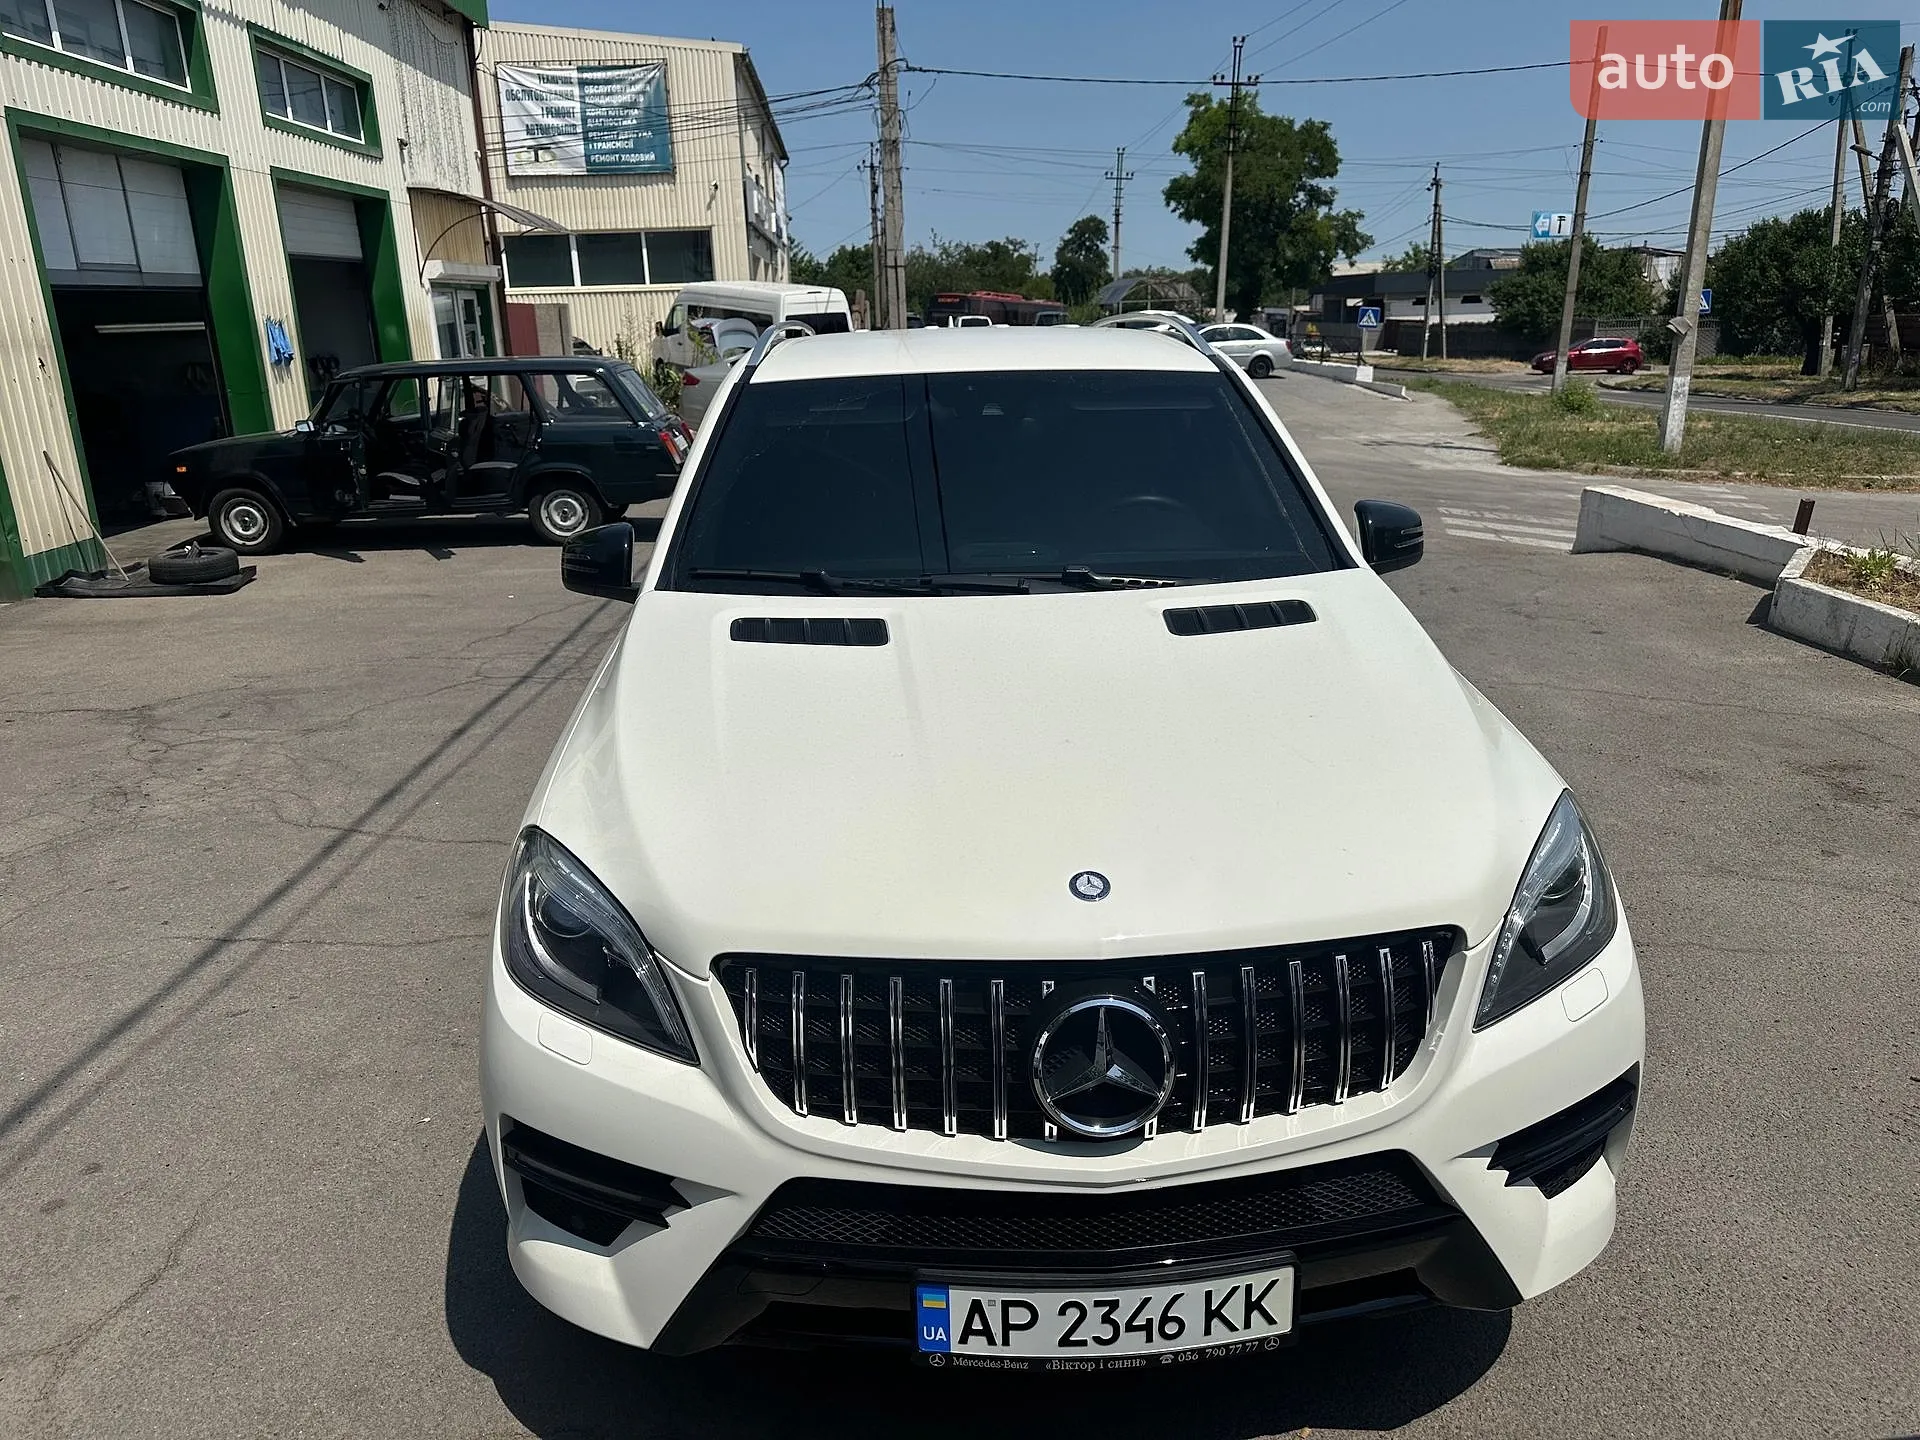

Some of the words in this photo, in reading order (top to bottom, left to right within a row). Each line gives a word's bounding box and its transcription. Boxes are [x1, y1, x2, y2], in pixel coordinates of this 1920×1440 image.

[546, 106, 576, 118] РЕМОНТ
[526, 123, 578, 136] АВТОМОБІЛІВ
[590, 153, 620, 163] РЕМОНТ
[957, 1297, 1039, 1347] AP
[1057, 1292, 1186, 1348] 2346
[1203, 1278, 1281, 1337] KK
[923, 1326, 948, 1342] UA
[1177, 1352, 1199, 1362] 056
[1205, 1347, 1226, 1359] 790
[1229, 1344, 1243, 1355] 77
[1245, 1341, 1259, 1352] 77
[952, 1356, 1029, 1371] Mercedes-Benz
